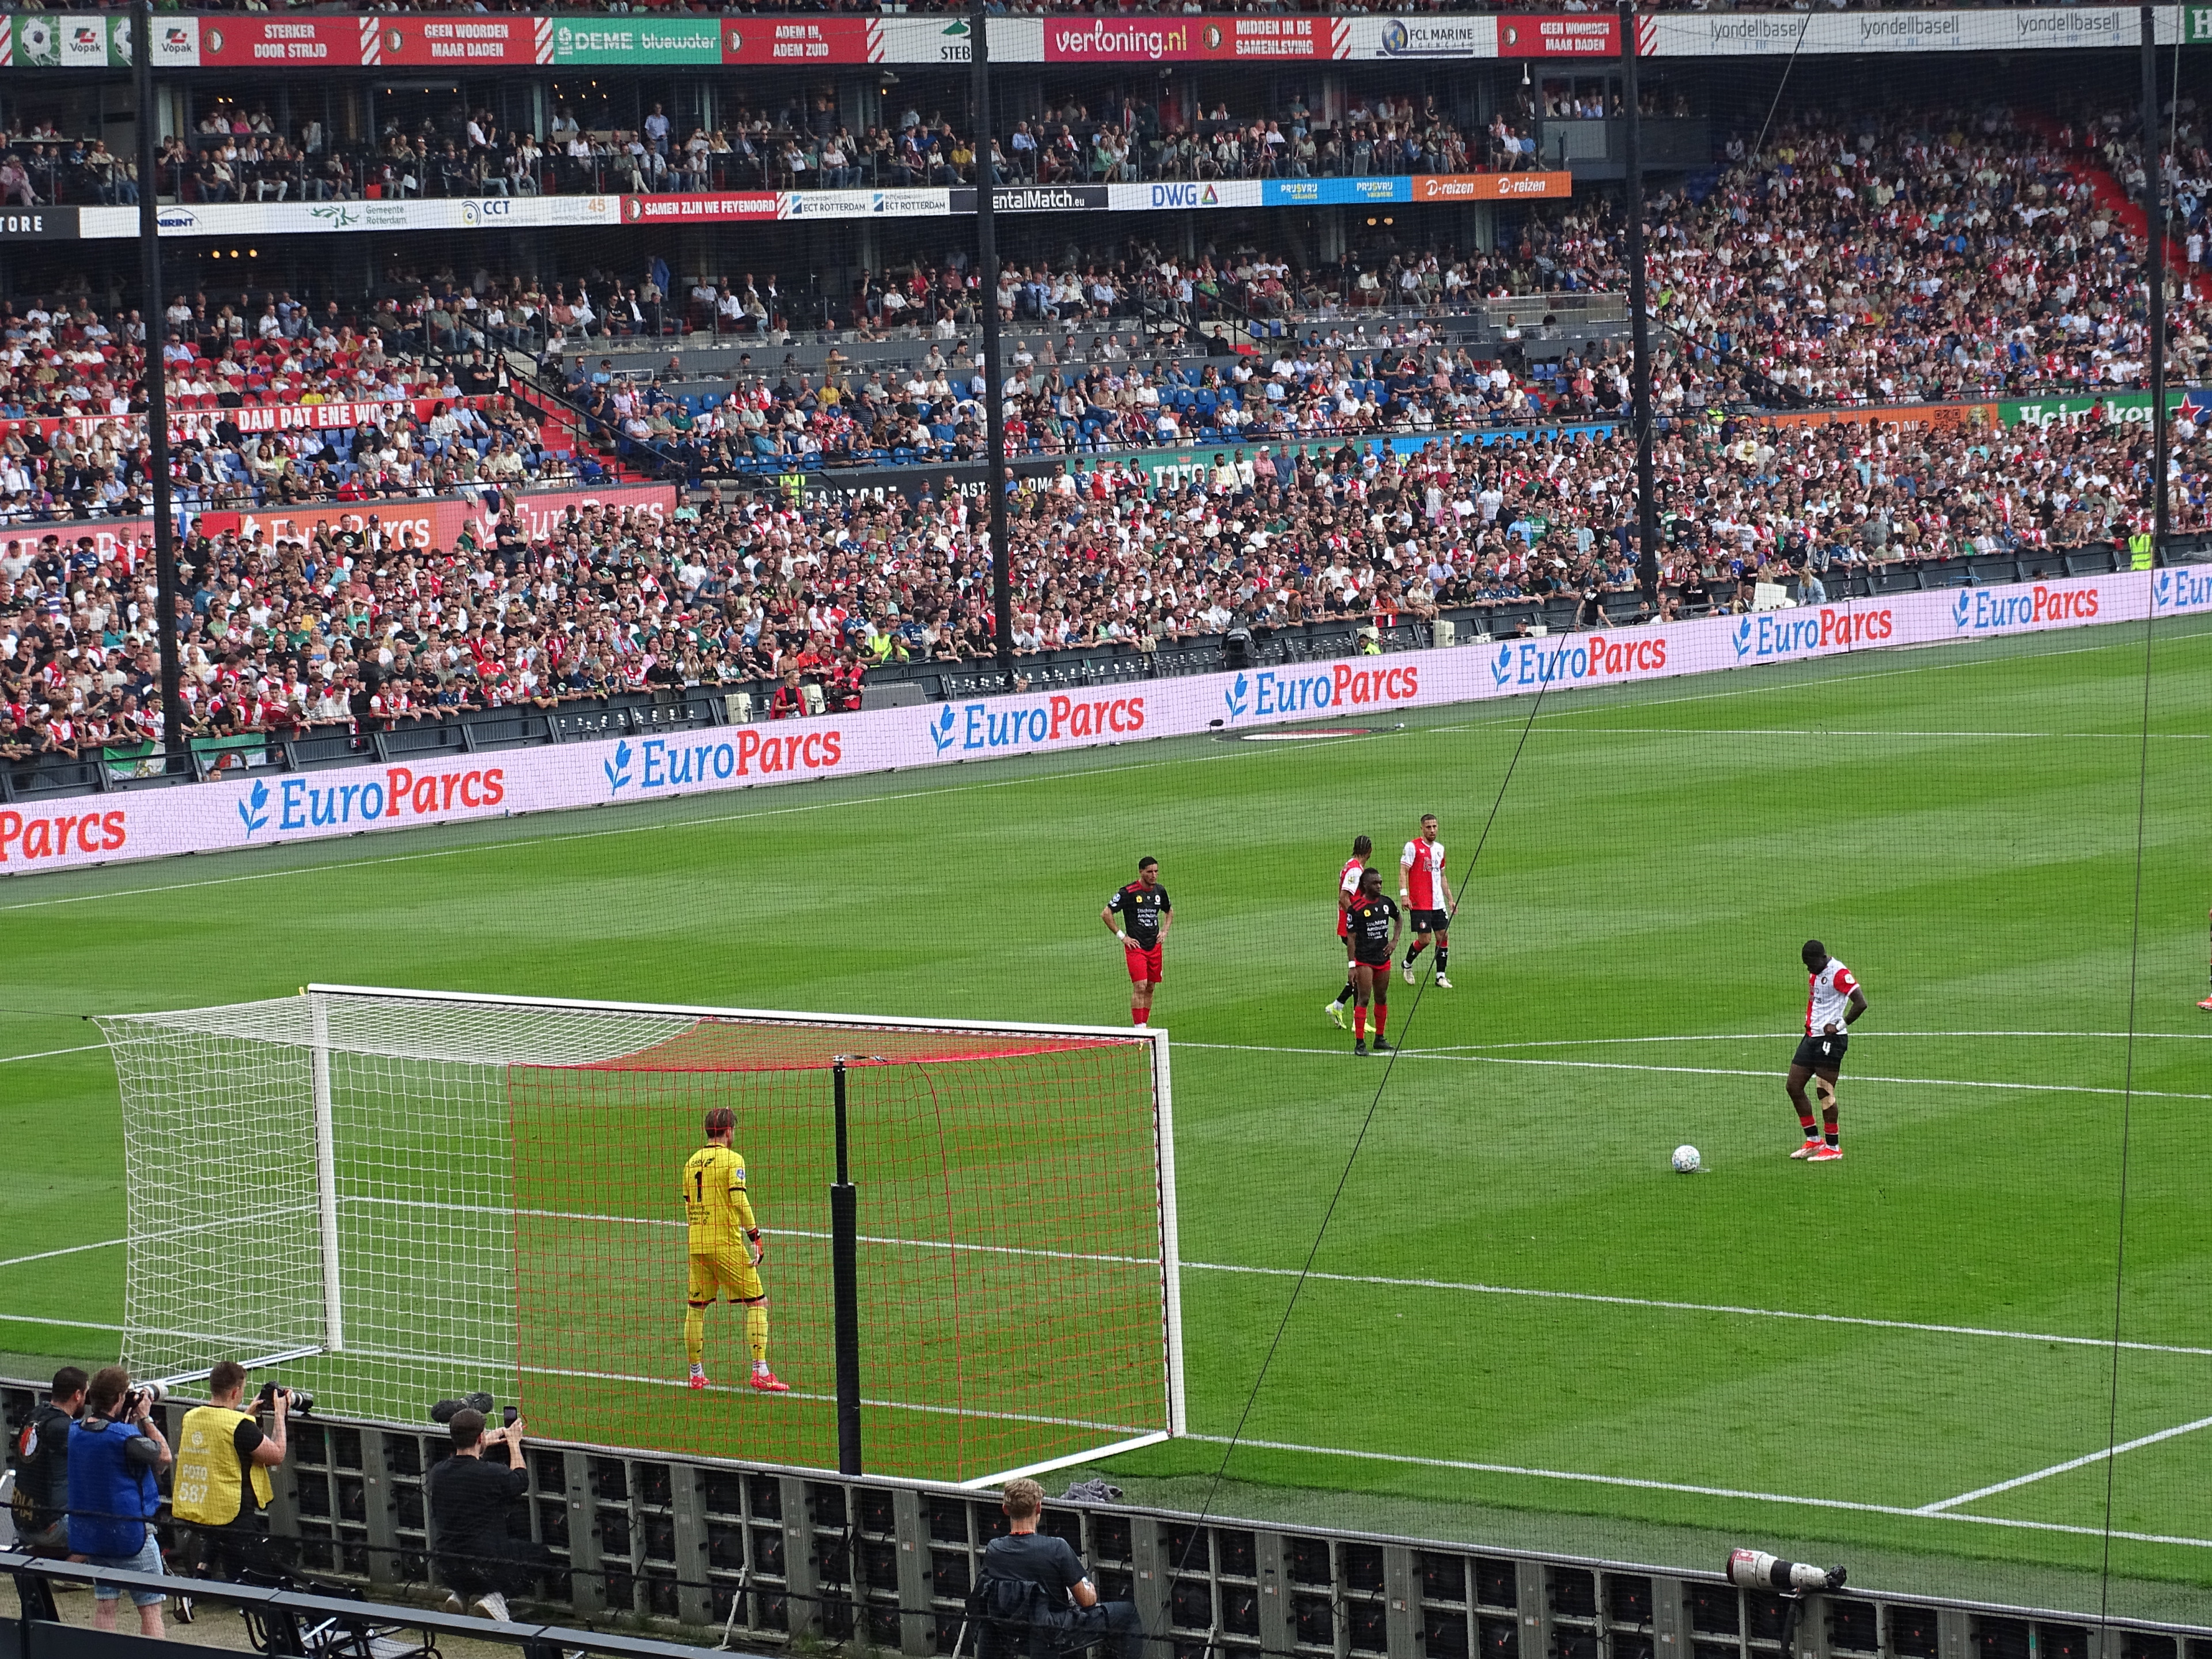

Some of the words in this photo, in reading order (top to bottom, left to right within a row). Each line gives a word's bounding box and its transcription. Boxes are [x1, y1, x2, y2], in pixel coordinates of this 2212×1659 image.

[264, 24, 315, 39] STERKER
[424, 24, 454, 39] GEEN
[455, 24, 508, 39] WOORDEN
[1236, 21, 1280, 36] MIDDEN
[1282, 21, 1296, 35] IN
[1296, 20, 1312, 35] DE
[1540, 23, 1564, 35] GEEN
[1565, 22, 1610, 35] WOORDEN
[1711, 18, 1804, 41] lyondellbasell
[1861, 16, 1959, 39] lyondellbasell
[2017, 12, 2120, 35] lyondellbasell
[2192, 9, 2212, 39] H
[775, 25, 805, 40] ADEM
[1055, 19, 1187, 59] verloning.nl
[1410, 29, 1429, 40] FCL
[1431, 29, 1473, 40] MARINE
[70, 43, 102, 54] Vopak
[161, 43, 192, 54] Vopak
[575, 32, 633, 50] DEME
[641, 32, 717, 50] bluewater
[1236, 40, 1314, 55] SAMENLEVING
[1546, 39, 1573, 51] MAAR
[1574, 38, 1605, 51] DADEN
[254, 44, 286, 59] DOOR
[288, 44, 327, 58] STRIJD
[431, 43, 464, 57] MAAR
[467, 42, 504, 56] DADEN
[772, 43, 804, 58] ADEM
[805, 43, 829, 57] ZUID
[941, 46, 971, 60] STEB
[992, 190, 1085, 209] entalMatch.eu
[1153, 184, 1196, 206] DWG
[366, 205, 404, 214] Gemeente
[484, 200, 510, 215] CCT
[589, 199, 606, 213] 45
[645, 202, 677, 216] SAMEN
[681, 201, 702, 215] ZIJN
[703, 201, 719, 214] WE
[719, 199, 775, 214] FEYENOORD
[803, 203, 819, 213] ECT
[820, 202, 865, 212] ROTTERDAM
[885, 202, 901, 211] ECT
[902, 200, 945, 210] ROTTERDAM
[366, 215, 407, 225] Rotterdam
[238, 409, 274, 430] DAN
[281, 406, 312, 427] DAT
[318, 404, 351, 426] ENE
[1975, 586, 2099, 629] EuroParcs
[1756, 608, 1893, 656] EuroParcs
[1517, 636, 1666, 685] EuroParcs
[1255, 664, 1418, 715] EuroParcs
[963, 695, 1144, 749] EuroParcs
[641, 729, 842, 788] EuroParcs
[279, 767, 504, 830] EuroParcs
[695, 1171, 702, 1203] 1
[183, 1464, 207, 1481] FOTO
[179, 1482, 208, 1505] 587
